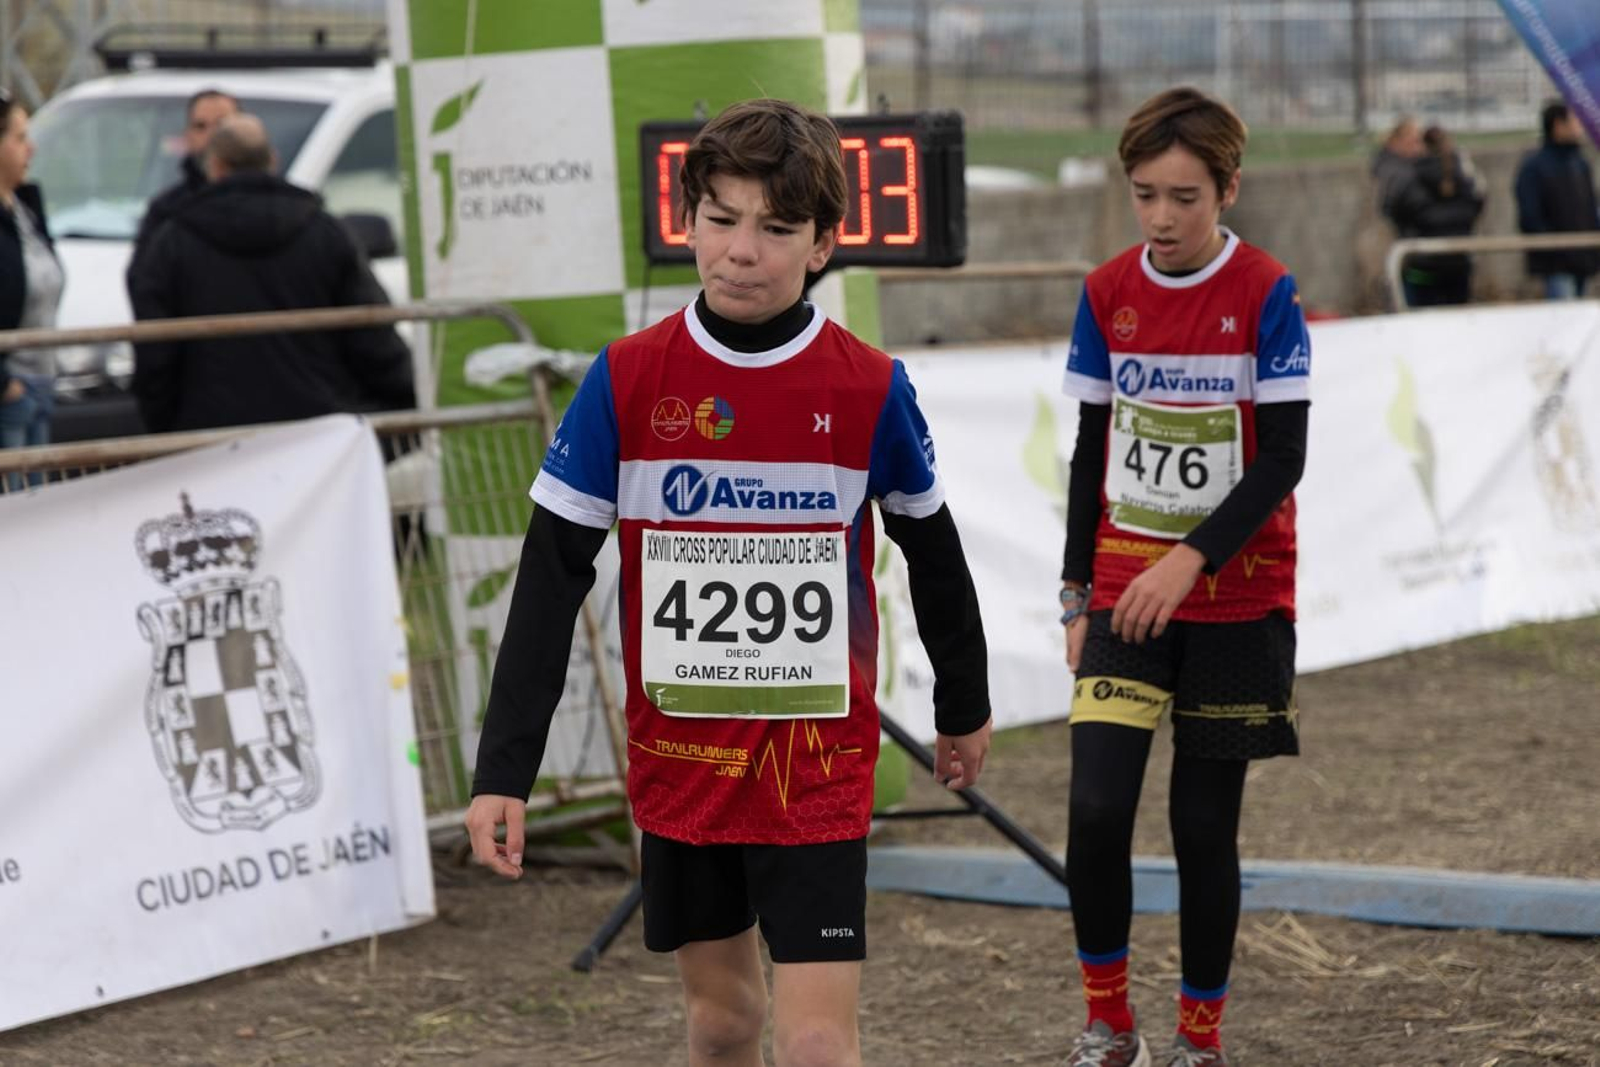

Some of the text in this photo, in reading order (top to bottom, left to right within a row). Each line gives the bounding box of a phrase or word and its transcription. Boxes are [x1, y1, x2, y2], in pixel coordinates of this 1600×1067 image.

[457, 159, 592, 190] DIPUTACIÓN
[460, 196, 487, 220] DE
[1149, 367, 1235, 392] Avanza
[1124, 438, 1209, 490] 476
[710, 477, 836, 510] Avanza
[734, 478, 763, 488] GRUPO
[673, 536, 705, 563] CROSS
[708, 537, 755, 564] POPULAR
[758, 537, 795, 564] CIUDAD
[799, 538, 811, 563] DE
[653, 579, 833, 644] 4299
[725, 648, 760, 658] DIEGO
[675, 664, 812, 681] GAMEZ RUFIAN
[655, 739, 748, 760] TRAILRUNNERS
[136, 821, 392, 912] CIUDAD DE JAÉN
[821, 928, 855, 938] KIPSTA
